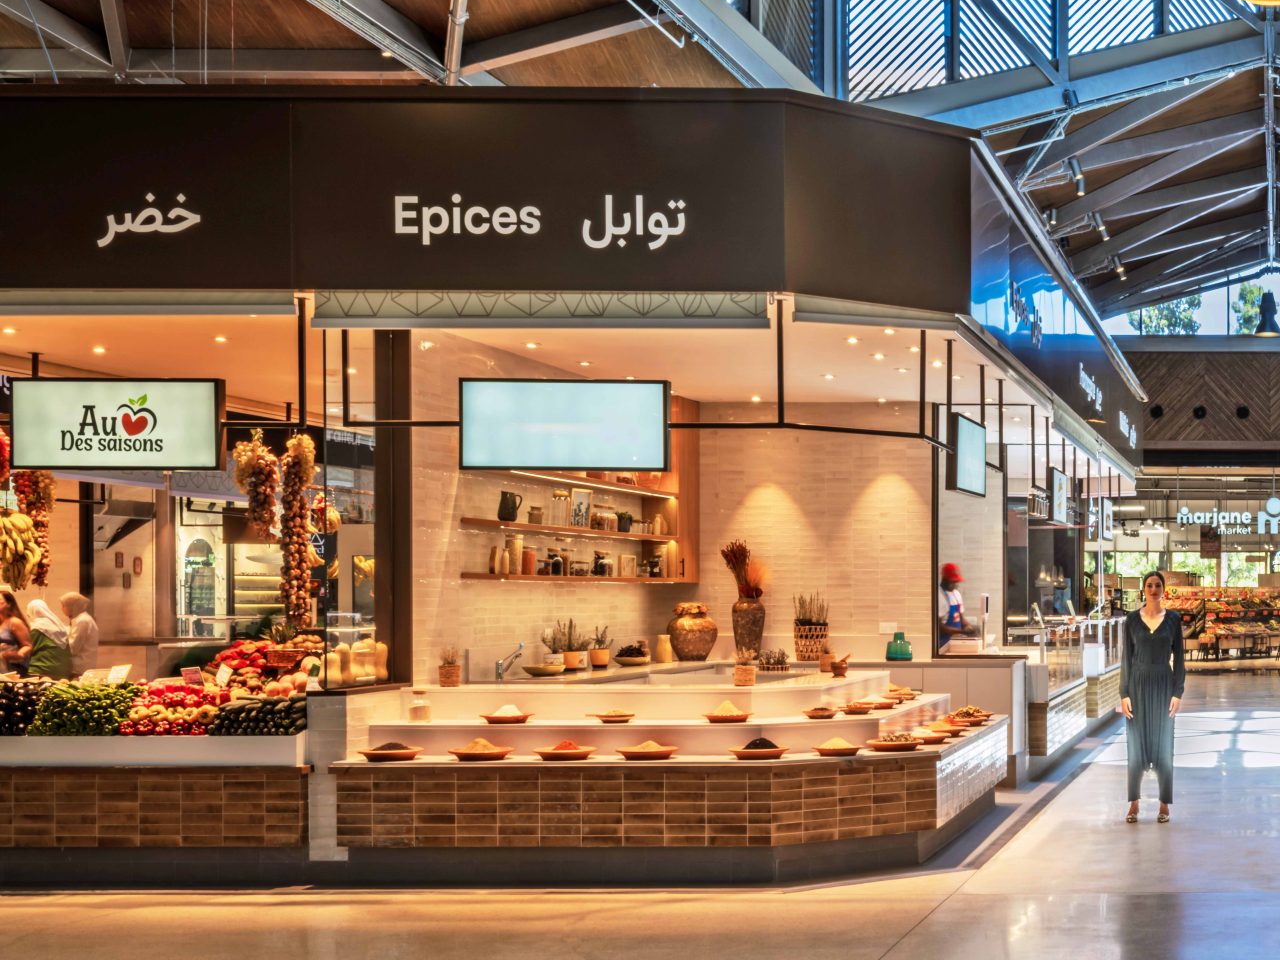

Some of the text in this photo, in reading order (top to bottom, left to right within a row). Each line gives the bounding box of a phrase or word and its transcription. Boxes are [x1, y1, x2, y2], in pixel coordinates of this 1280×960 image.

[97, 192, 201, 247] خضر
[394, 194, 542, 245] Epices
[581, 194, 687, 250] توابل
[78, 405, 117, 436] Au
[60, 430, 163, 452] Des saisons
[1177, 506, 1251, 527] marjane
[1217, 525, 1251, 535] market
